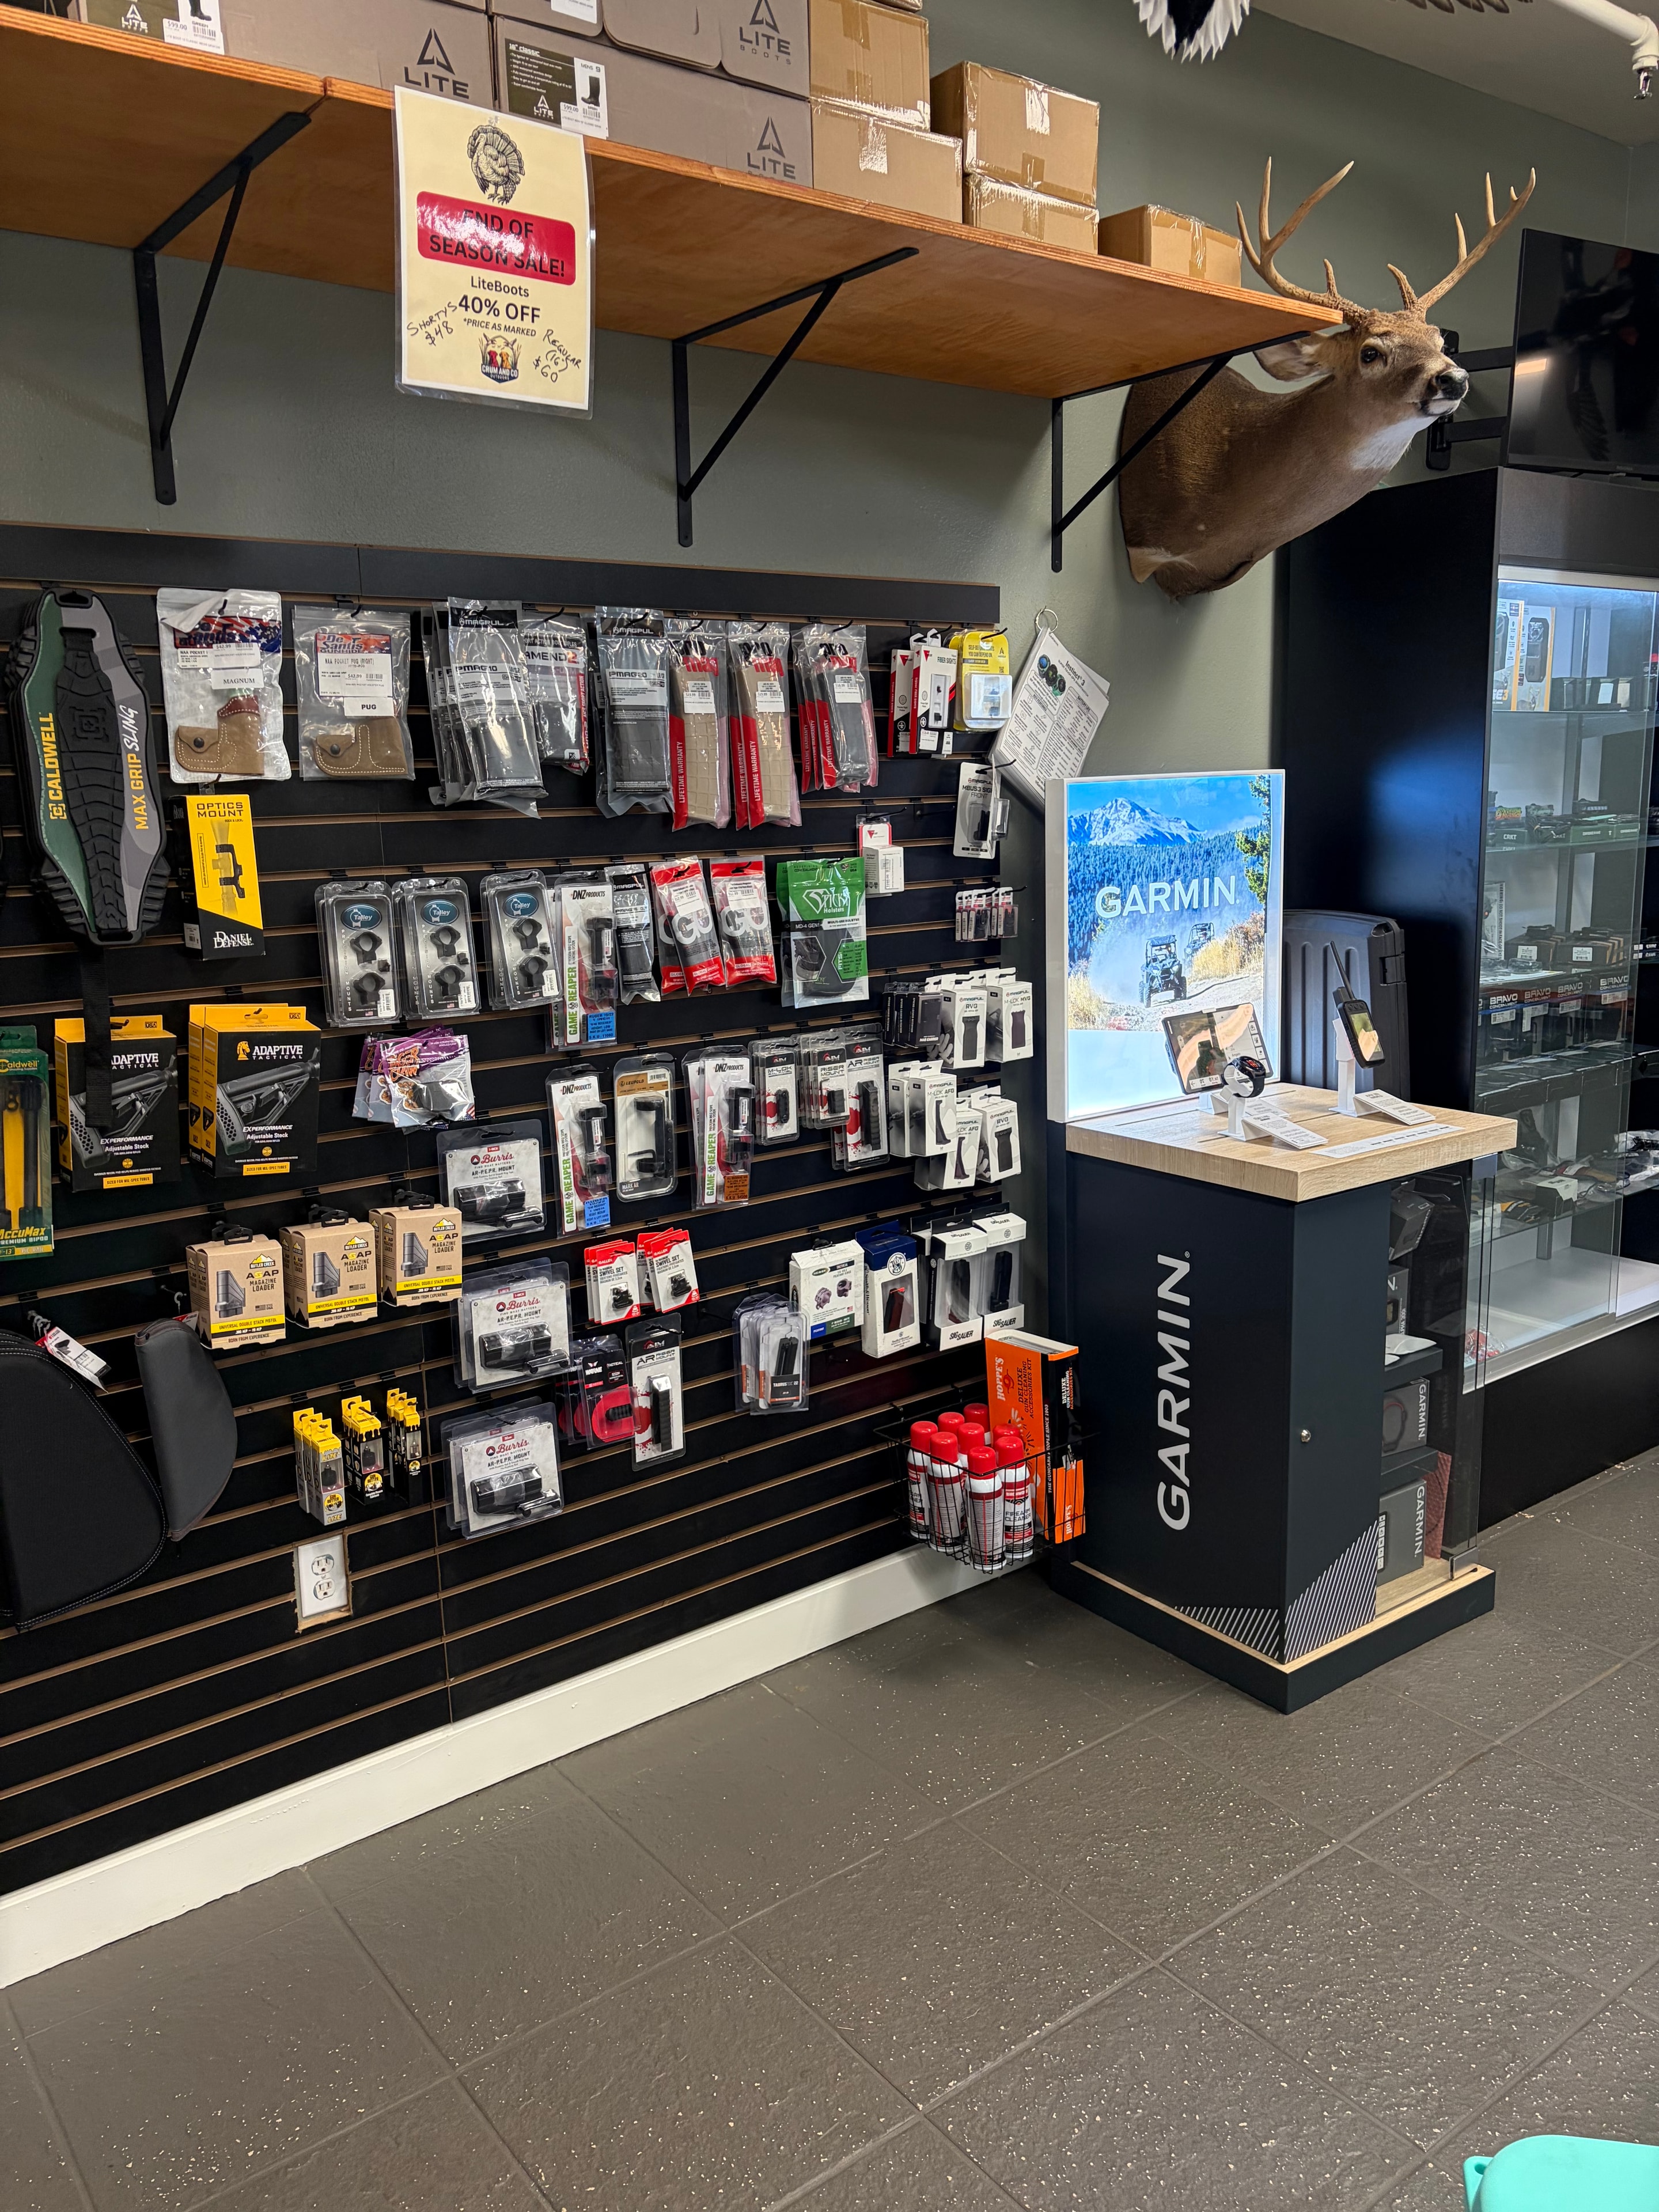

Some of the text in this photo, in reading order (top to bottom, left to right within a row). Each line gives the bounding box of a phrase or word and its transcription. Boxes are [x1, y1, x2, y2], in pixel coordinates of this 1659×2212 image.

[168, 21, 187, 31] $99.00
[740, 26, 790, 56] LITE
[519, 46, 540, 57] classic
[740, 44, 791, 65] BOOTS
[404, 66, 469, 99] LITE
[747, 152, 796, 181] LITE
[464, 209, 534, 239] END OF
[430, 235, 565, 278] SEASON SALE!
[471, 275, 529, 298] LiteBoots
[459, 294, 540, 324] 40% OFF
[407, 301, 459, 336] SHORTYS
[425, 320, 454, 347] $48
[491, 321, 503, 332] AS
[503, 323, 536, 338] MARKED
[543, 329, 582, 369] REGULAR
[482, 365, 518, 378] CRUM AND CO
[533, 357, 558, 383] $60
[525, 651, 579, 664] AMEND2
[40, 713, 63, 801] CALDWELL
[750, 741, 759, 771] WARRANTY
[119, 705, 149, 830] MAX GRIP SLING
[197, 802, 243, 810] OPTICS
[573, 889, 586, 900] DNZ
[1095, 876, 1237, 919] GARMIN
[514, 901, 531, 910] Talley
[354, 913, 373, 922] Talley
[432, 908, 450, 918] Talley
[215, 931, 252, 942] DANIEL
[213, 937, 254, 949] DEFENSE
[1525, 988, 1551, 999] BRAVO
[1558, 982, 1583, 993] BRAVO
[569, 967, 578, 1036] GAME REAPER
[1490, 994, 1518, 1005] BRAVO
[252, 1045, 303, 1055] ADAPTIVE
[111, 1053, 159, 1065] DAPTIVE
[105, 1145, 133, 1153] Adjustable
[480, 1152, 514, 1165] Burris
[706, 1133, 717, 1197] GAME REAPER
[472, 1168, 497, 1177] AR-P.E.P.R.
[563, 1158, 574, 1224] GAME REAPER
[429, 1233, 459, 1242] ASAP
[341, 1251, 372, 1260] ASAP
[344, 1259, 370, 1267] MAGAZINE
[347, 1264, 368, 1272] LOADER
[246, 1270, 279, 1279] ASAP
[599, 1269, 615, 1277] SWIVEL
[249, 1277, 277, 1286] MAGAZINE
[252, 1283, 275, 1291] LOADER
[506, 1297, 540, 1310] Burris
[950, 1330, 974, 1340] SIG SAUER
[637, 1355, 656, 1365] AR
[585, 1367, 603, 1376] WARNE
[995, 1357, 1006, 1402] HOPPE'S
[1157, 1251, 1191, 1531] GARMIN
[1418, 1384, 1426, 1441] GARMIN
[496, 1439, 529, 1454] Burris
[322, 1452, 338, 1461] LITE
[1005, 1507, 1031, 1517] FIREARM
[1005, 1513, 1031, 1522] CLEANER
[327, 1514, 342, 1524] LITE
[1415, 1486, 1425, 1558] GARMIN
